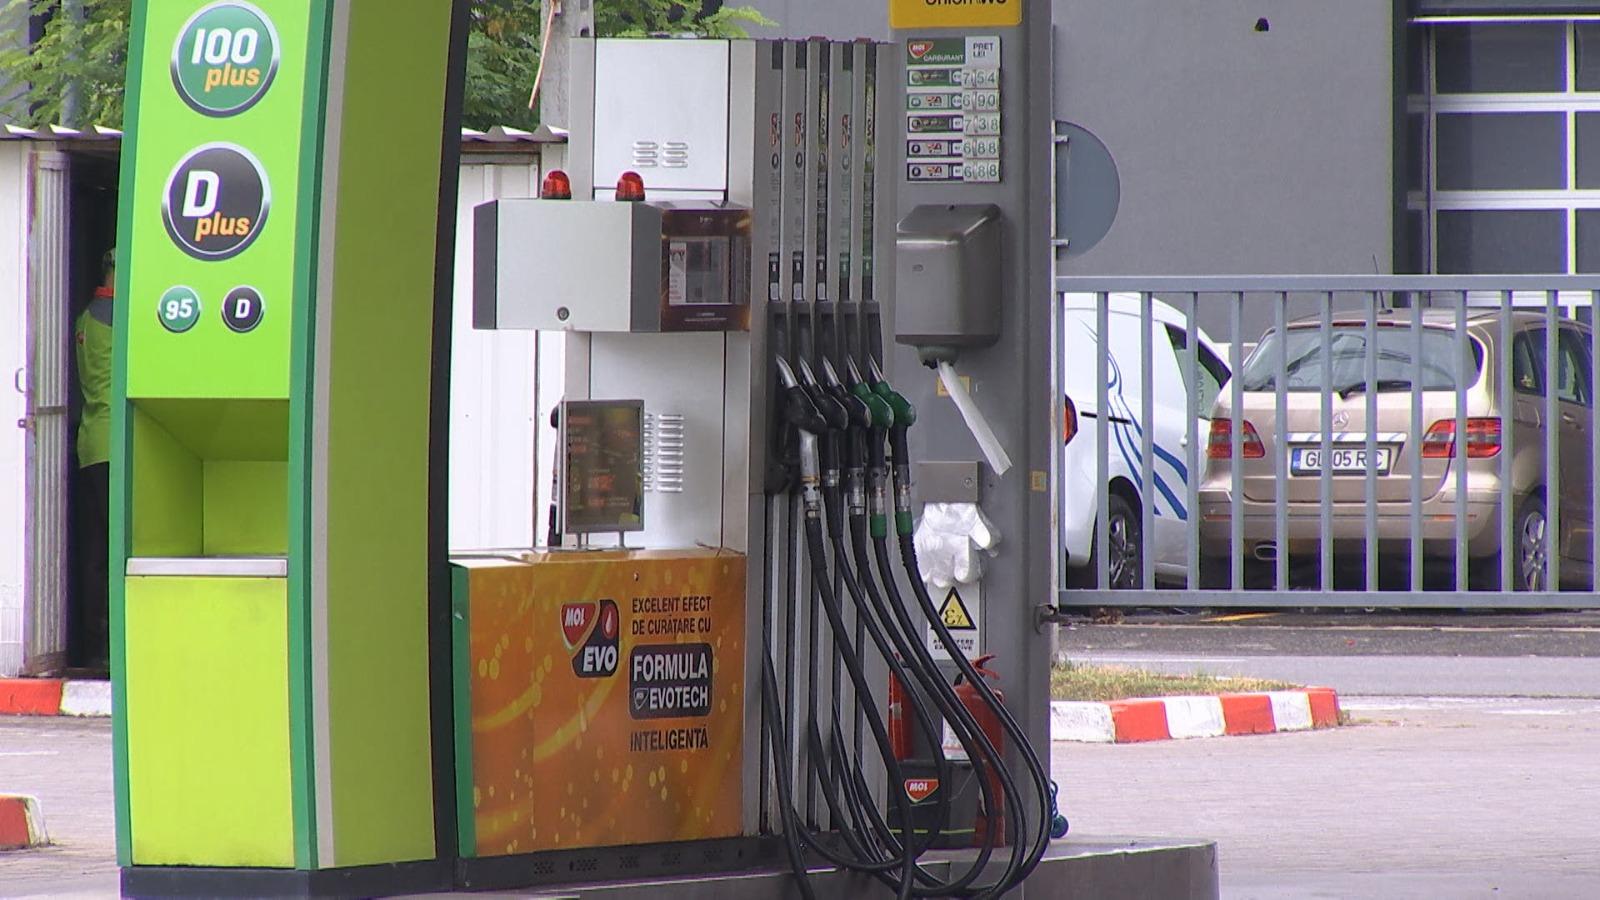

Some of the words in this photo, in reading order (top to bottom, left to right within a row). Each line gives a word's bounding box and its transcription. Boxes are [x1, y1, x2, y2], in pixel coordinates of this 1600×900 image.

[192, 28, 258, 65] 100
[204, 64, 260, 92] plus
[182, 170, 220, 217] D
[194, 212, 250, 242] plus
[165, 299, 193, 320] 95
[235, 299, 250, 319] D
[1333, 451, 1352, 467] 05
[632, 597, 680, 613] EXCELENT
[682, 596, 712, 612] EFECT
[565, 607, 585, 627] MOL
[632, 619, 645, 635] DE
[697, 617, 711, 633] CU
[582, 645, 617, 672] EVO
[633, 652, 708, 681] FORMULA
[649, 685, 708, 710] EVOTECH
[909, 782, 928, 791] MOL
